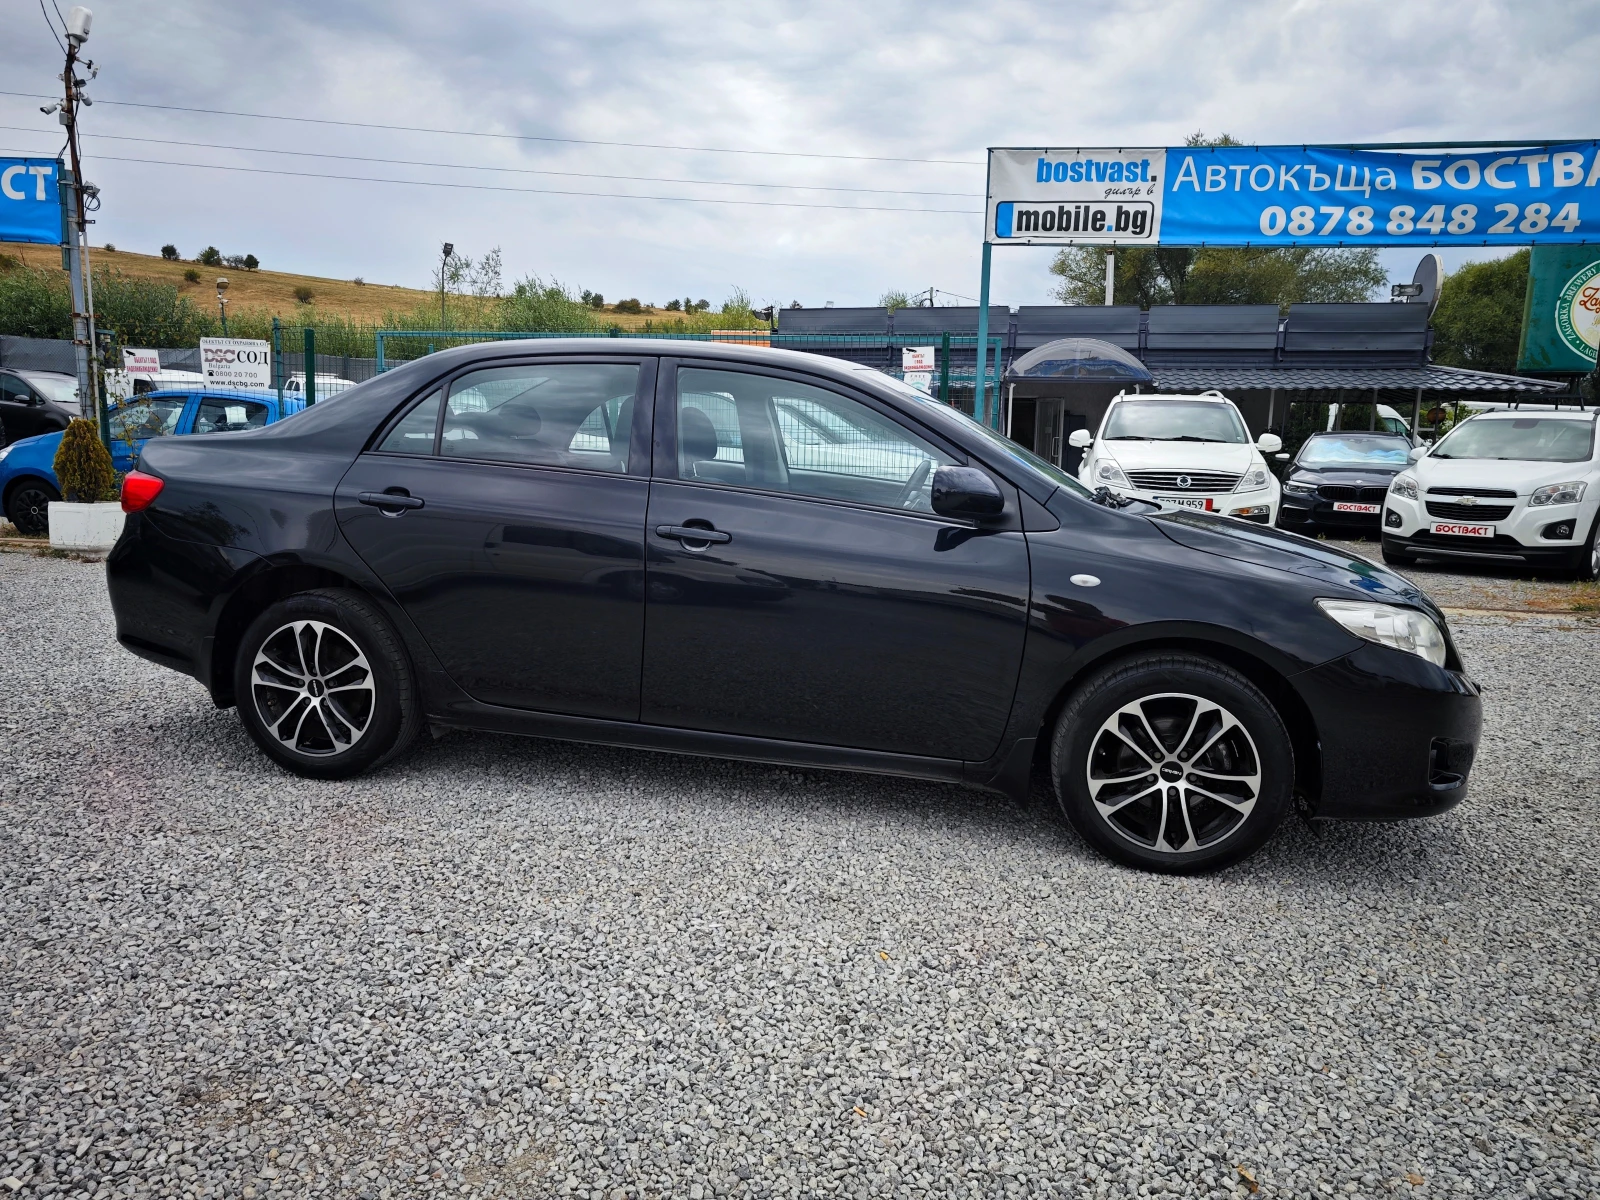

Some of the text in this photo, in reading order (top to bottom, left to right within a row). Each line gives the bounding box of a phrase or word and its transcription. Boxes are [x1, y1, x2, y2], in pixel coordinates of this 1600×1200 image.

[1, 165, 53, 201] СТ
[1036, 158, 1157, 183] bostvast.
[1172, 155, 1397, 199] Автокъща
[1104, 186, 1141, 199] дилър
[1016, 205, 1148, 236] mobile.bg
[1259, 202, 1582, 236] 0878 848 284
[1579, 286, 1600, 314] Za
[1560, 302, 1577, 341] ZAGORKA
[203, 348, 236, 364] DSC
[237, 350, 268, 366] СОД
[210, 380, 265, 388] www.dscbg.com
[1337, 503, 1376, 513] БОСТВАСТ
[1435, 524, 1489, 536] БОСТВАСТ
